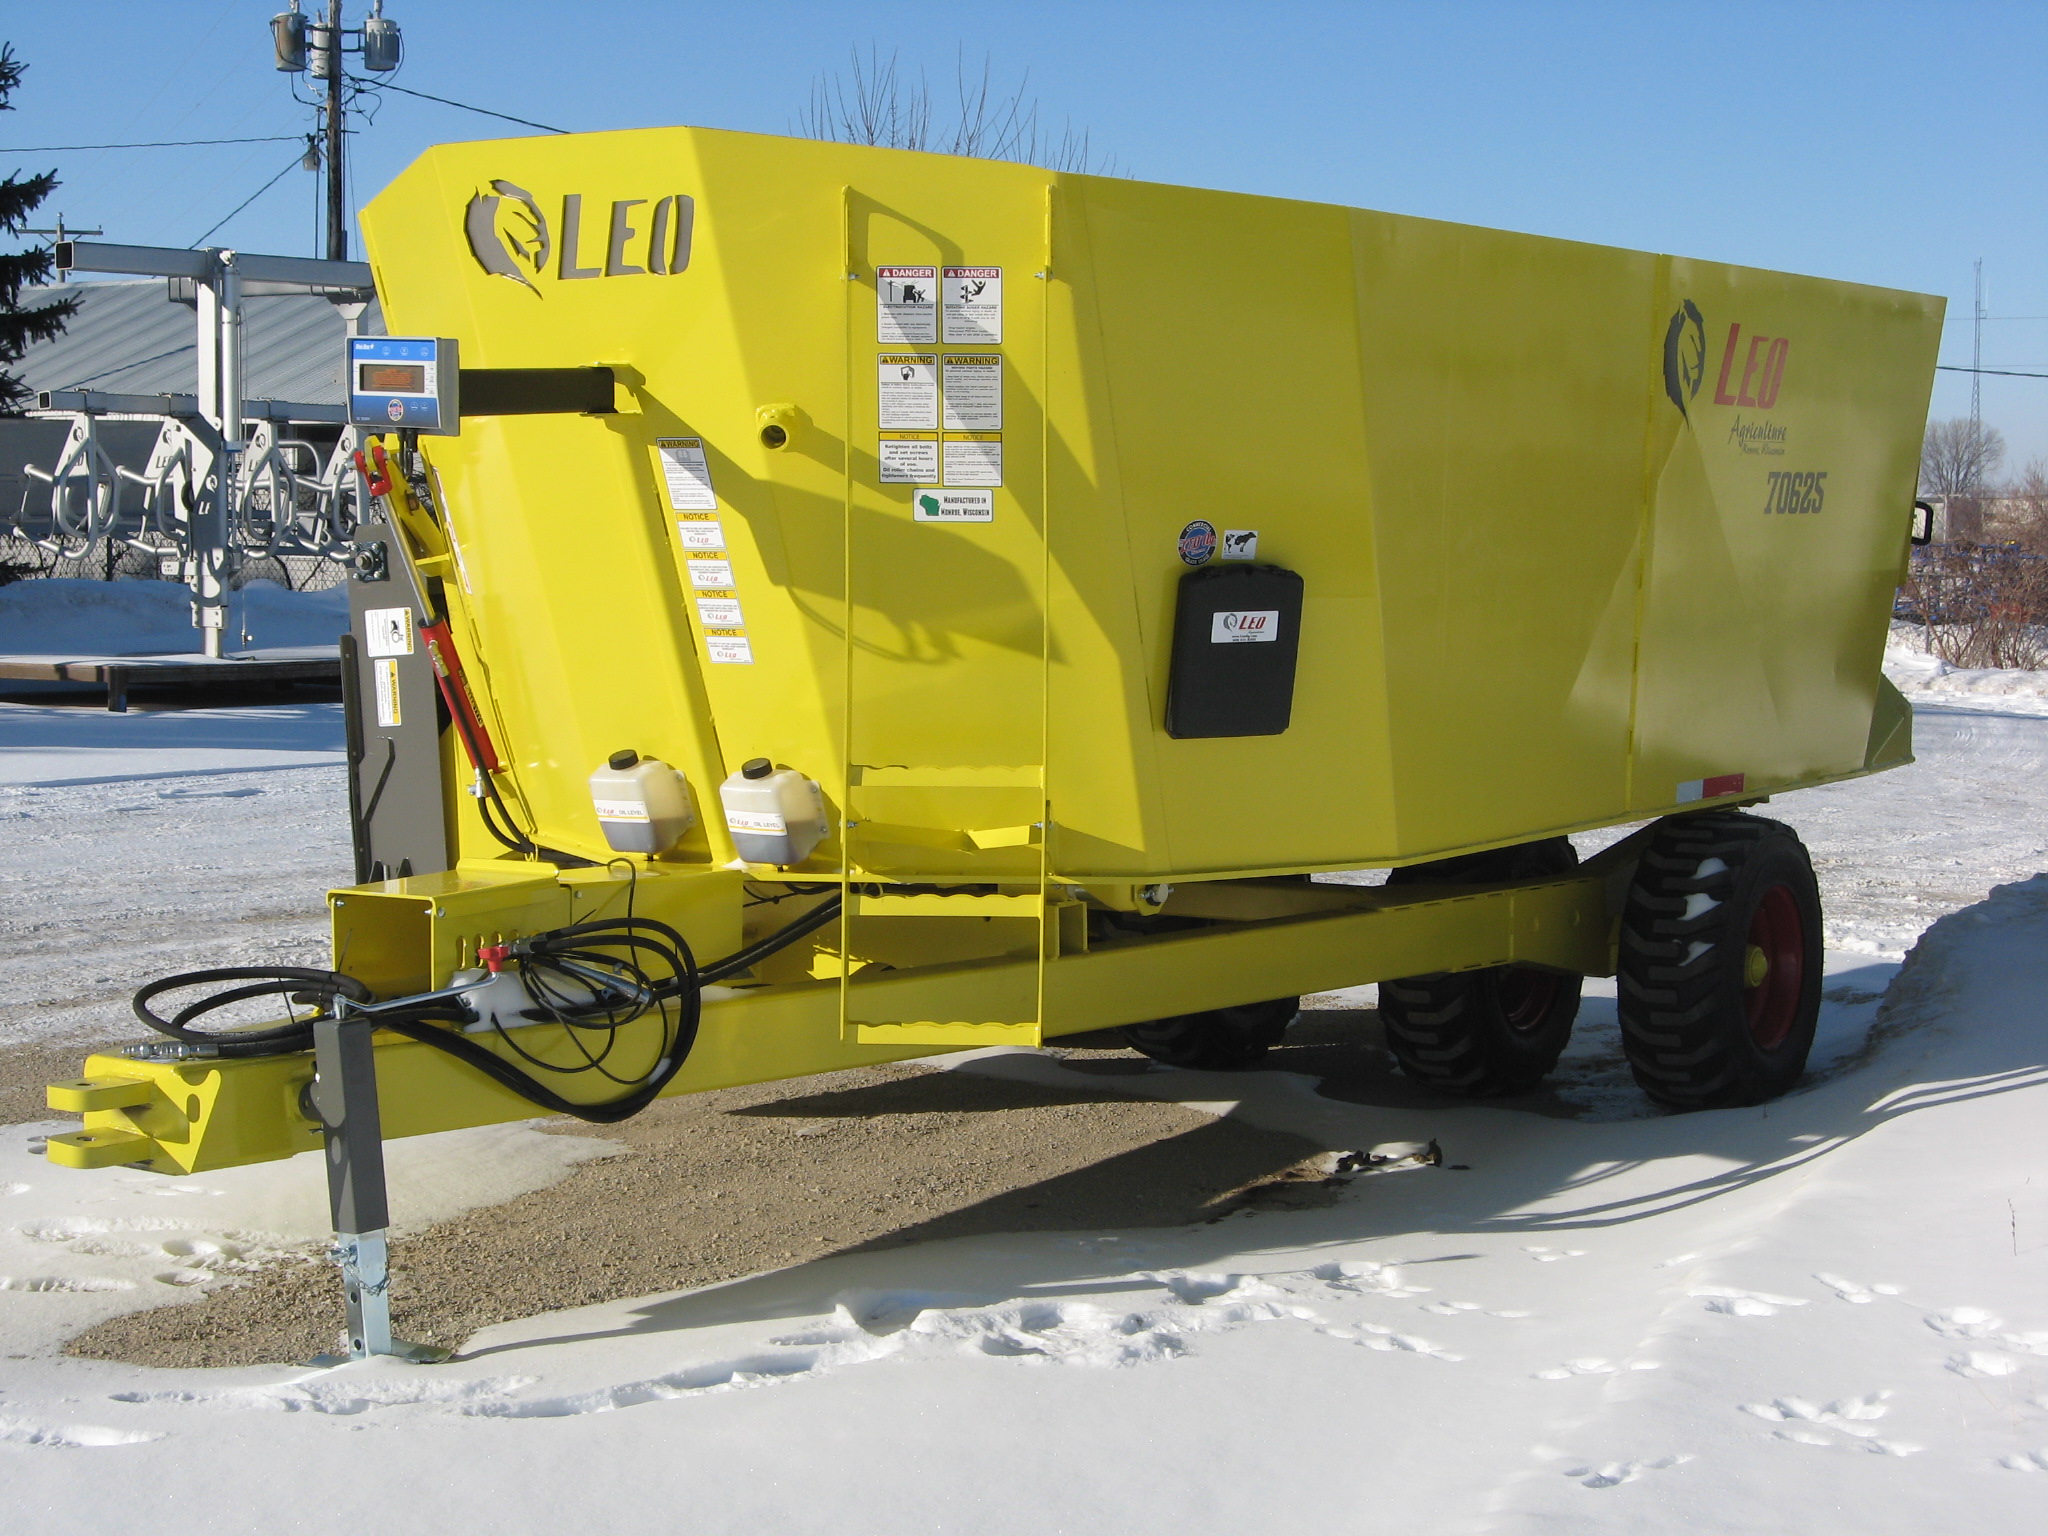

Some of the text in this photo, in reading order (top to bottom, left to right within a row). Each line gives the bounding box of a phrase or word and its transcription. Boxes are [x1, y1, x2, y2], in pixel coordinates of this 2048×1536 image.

[557, 193, 694, 280] LEO
[892, 269, 932, 277] DANGER
[957, 269, 997, 278] DANGER
[890, 356, 932, 364] WARNING
[955, 356, 998, 365] WARNING
[1714, 322, 1789, 409] LEO
[1728, 414, 1787, 447] Agriculture
[1763, 471, 1828, 514] 70625
[702, 590, 728, 598] NOTICE
[1238, 615, 1266, 630] LEO
